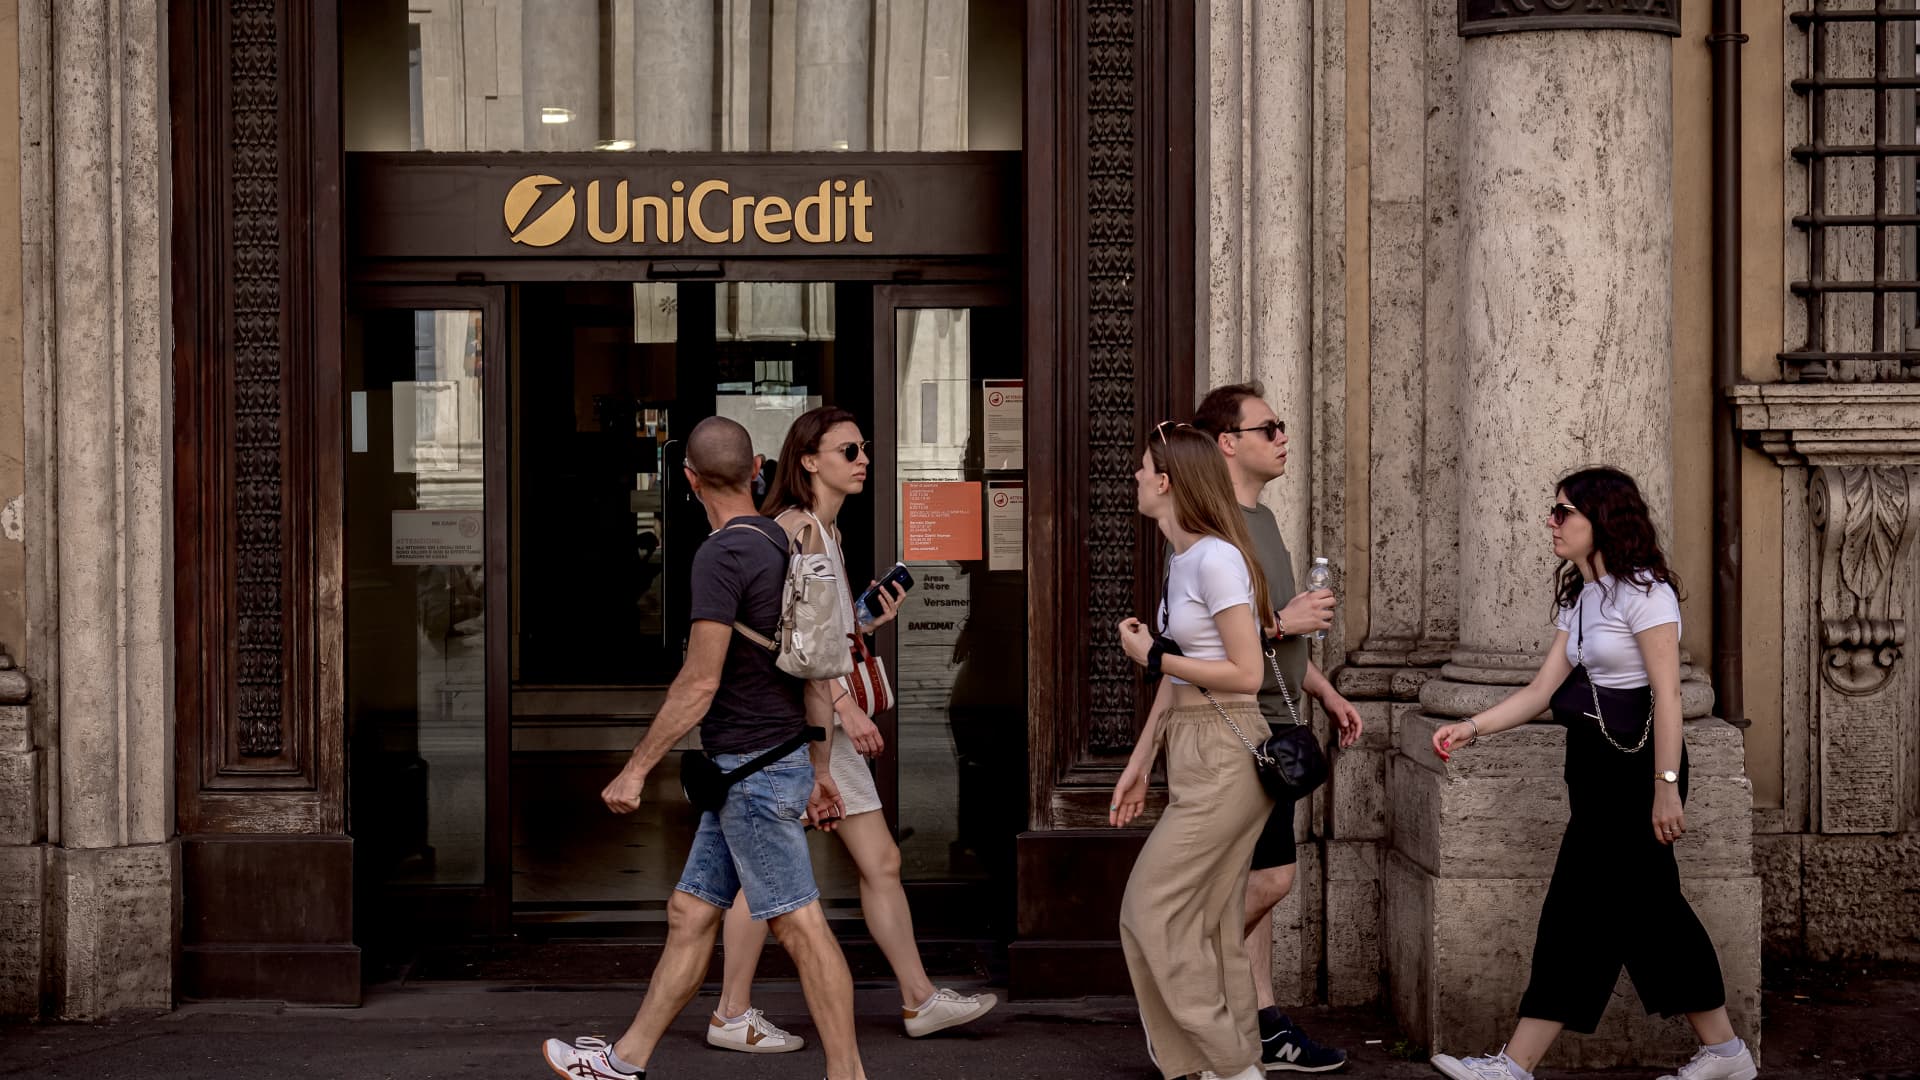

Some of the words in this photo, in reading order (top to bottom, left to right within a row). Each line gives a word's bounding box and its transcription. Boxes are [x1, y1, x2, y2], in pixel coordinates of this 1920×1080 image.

[587, 180, 873, 243] UniCredit
[923, 574, 945, 582] Area
[908, 621, 955, 631] BANCOMAT
